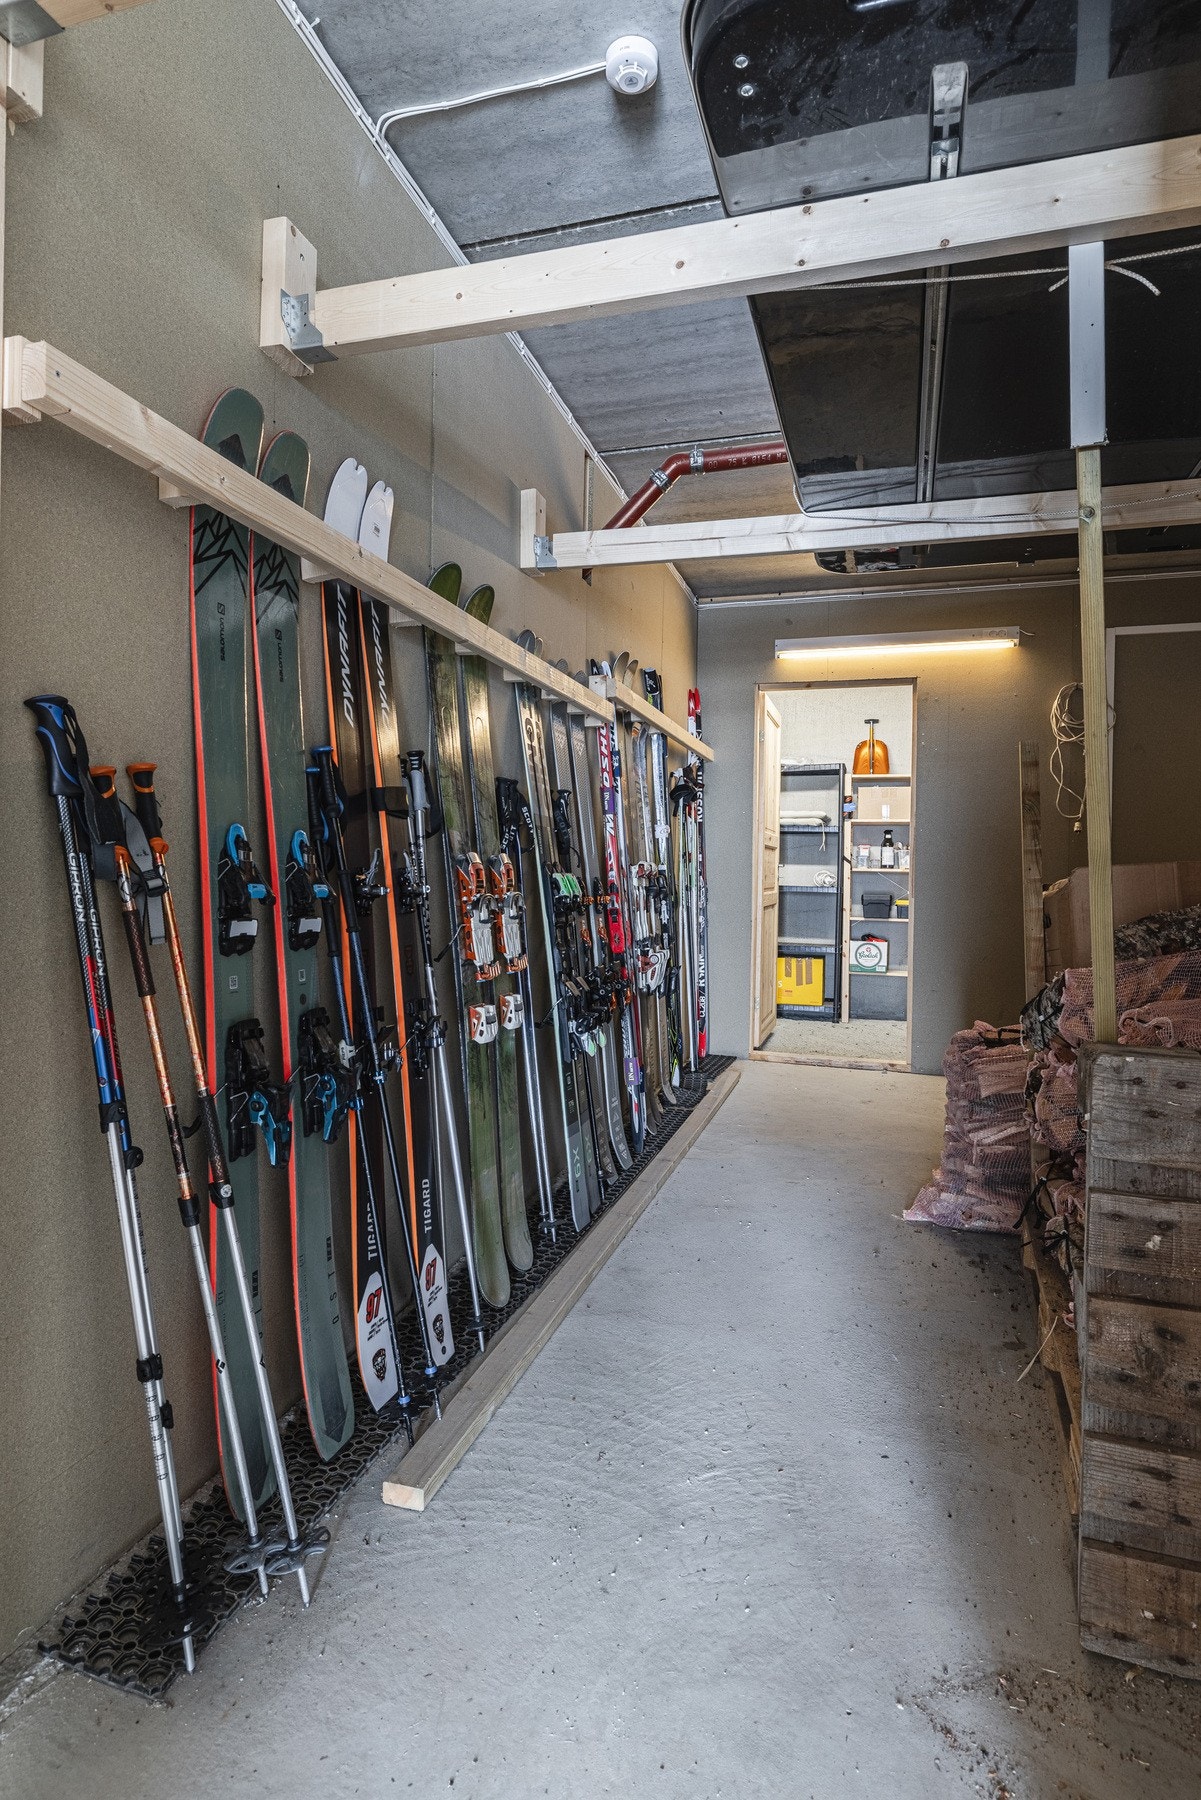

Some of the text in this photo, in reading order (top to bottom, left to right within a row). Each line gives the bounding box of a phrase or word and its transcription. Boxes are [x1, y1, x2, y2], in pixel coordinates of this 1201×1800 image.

[337, 583, 354, 728] DYNAFIT
[370, 600, 390, 730] DYNAFIT
[68, 852, 86, 922] GIPRON
[90, 908, 106, 976] GIPRON
[573, 1148, 581, 1178] X9
[366, 1202, 379, 1262] TIGAR
[422, 1178, 433, 1234] TIGARD
[425, 1257, 437, 1292] 97
[365, 1286, 383, 1324] 97
